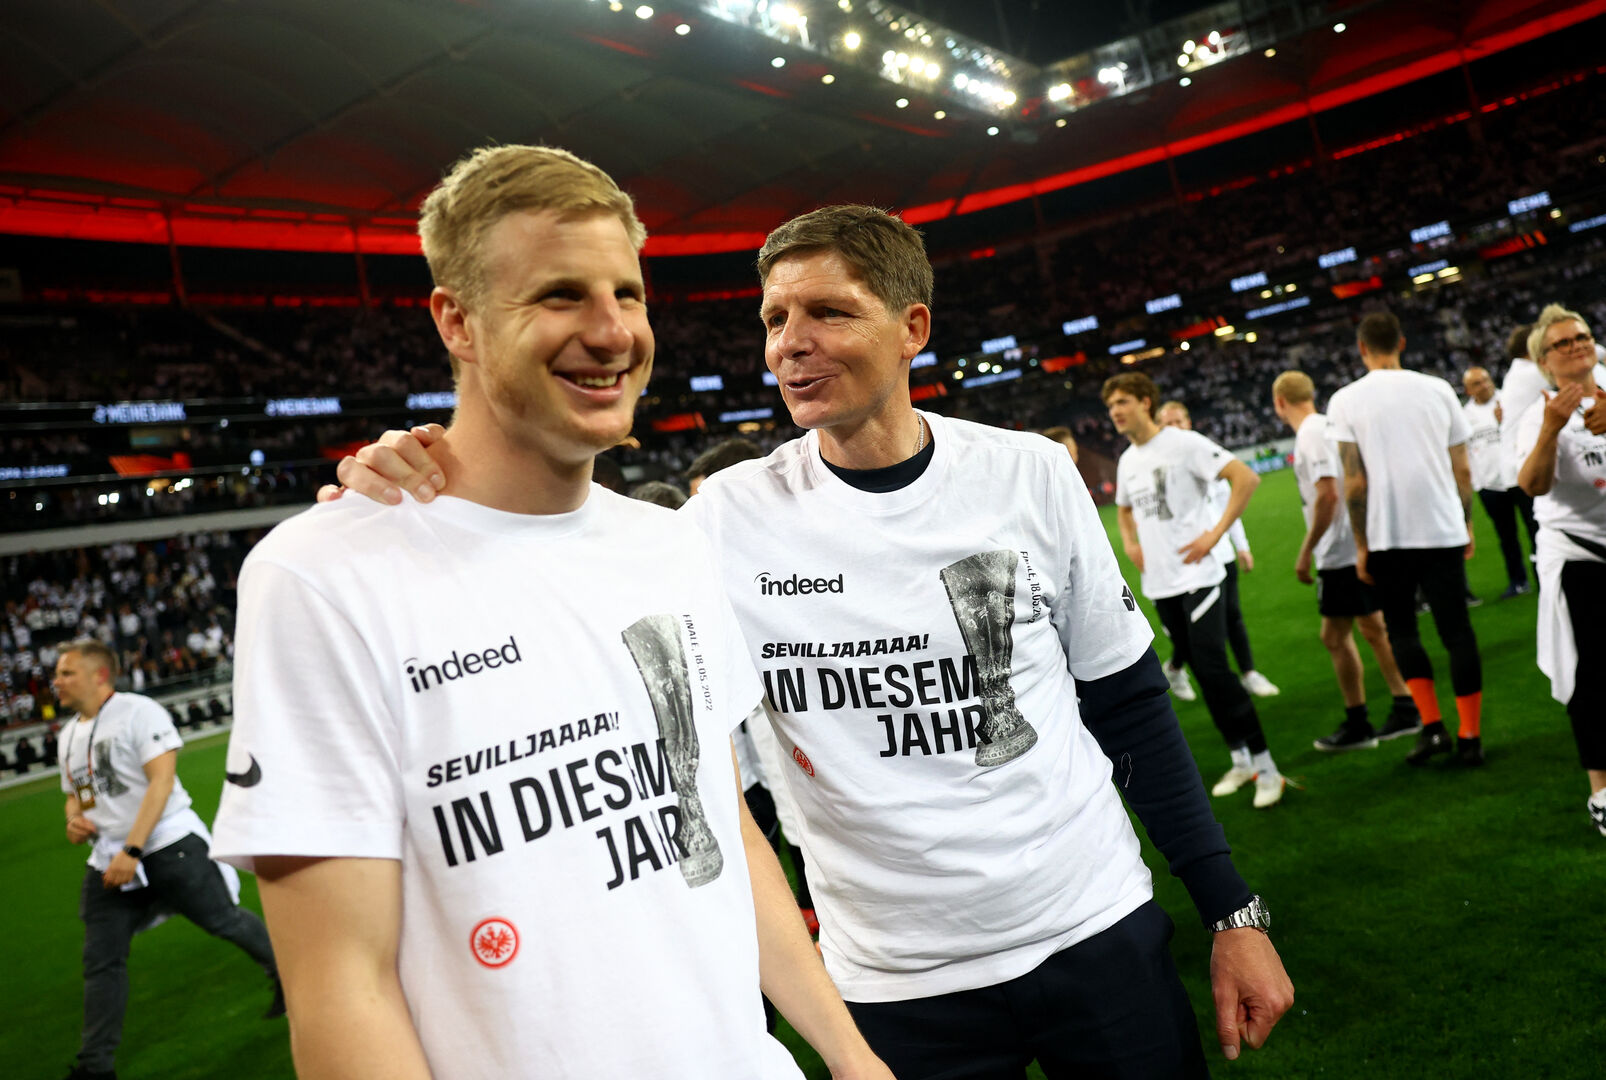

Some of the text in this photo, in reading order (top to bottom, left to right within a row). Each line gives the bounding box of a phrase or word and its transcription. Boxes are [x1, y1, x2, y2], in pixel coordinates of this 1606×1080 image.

[755, 572, 844, 596] indeed
[404, 636, 522, 693] indeed
[761, 634, 929, 659] SEVILLJAAAAA!
[763, 655, 981, 713] IN DIESEM
[877, 704, 993, 758] JAHR
[433, 738, 677, 868] IN DIESM
[596, 804, 691, 891] JAR
